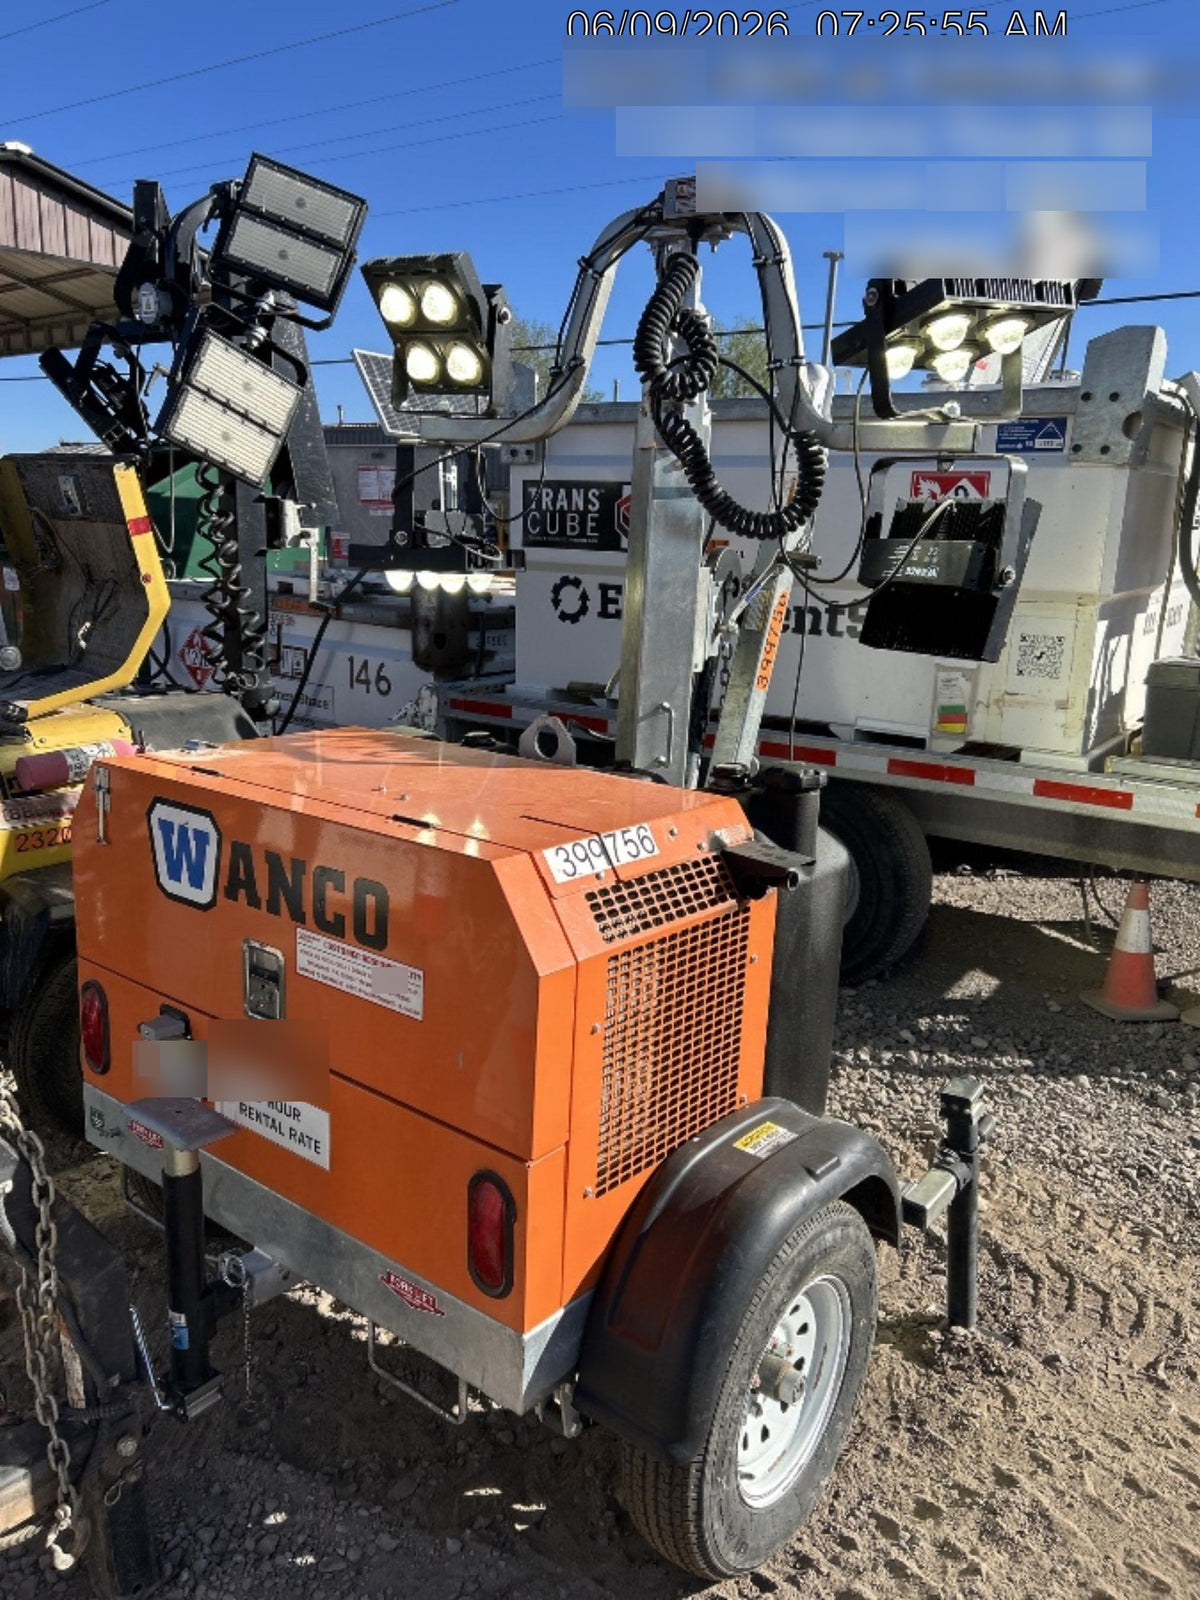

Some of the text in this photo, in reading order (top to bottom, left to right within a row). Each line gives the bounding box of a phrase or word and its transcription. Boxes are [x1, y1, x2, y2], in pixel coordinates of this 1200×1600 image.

[527, 488, 600, 511] TRANS
[527, 511, 600, 537] CUBE
[349, 655, 392, 697] 146
[555, 825, 656, 878] 399756
[156, 816, 390, 951] WANCO
[239, 1102, 321, 1155] RENTAL RATE
